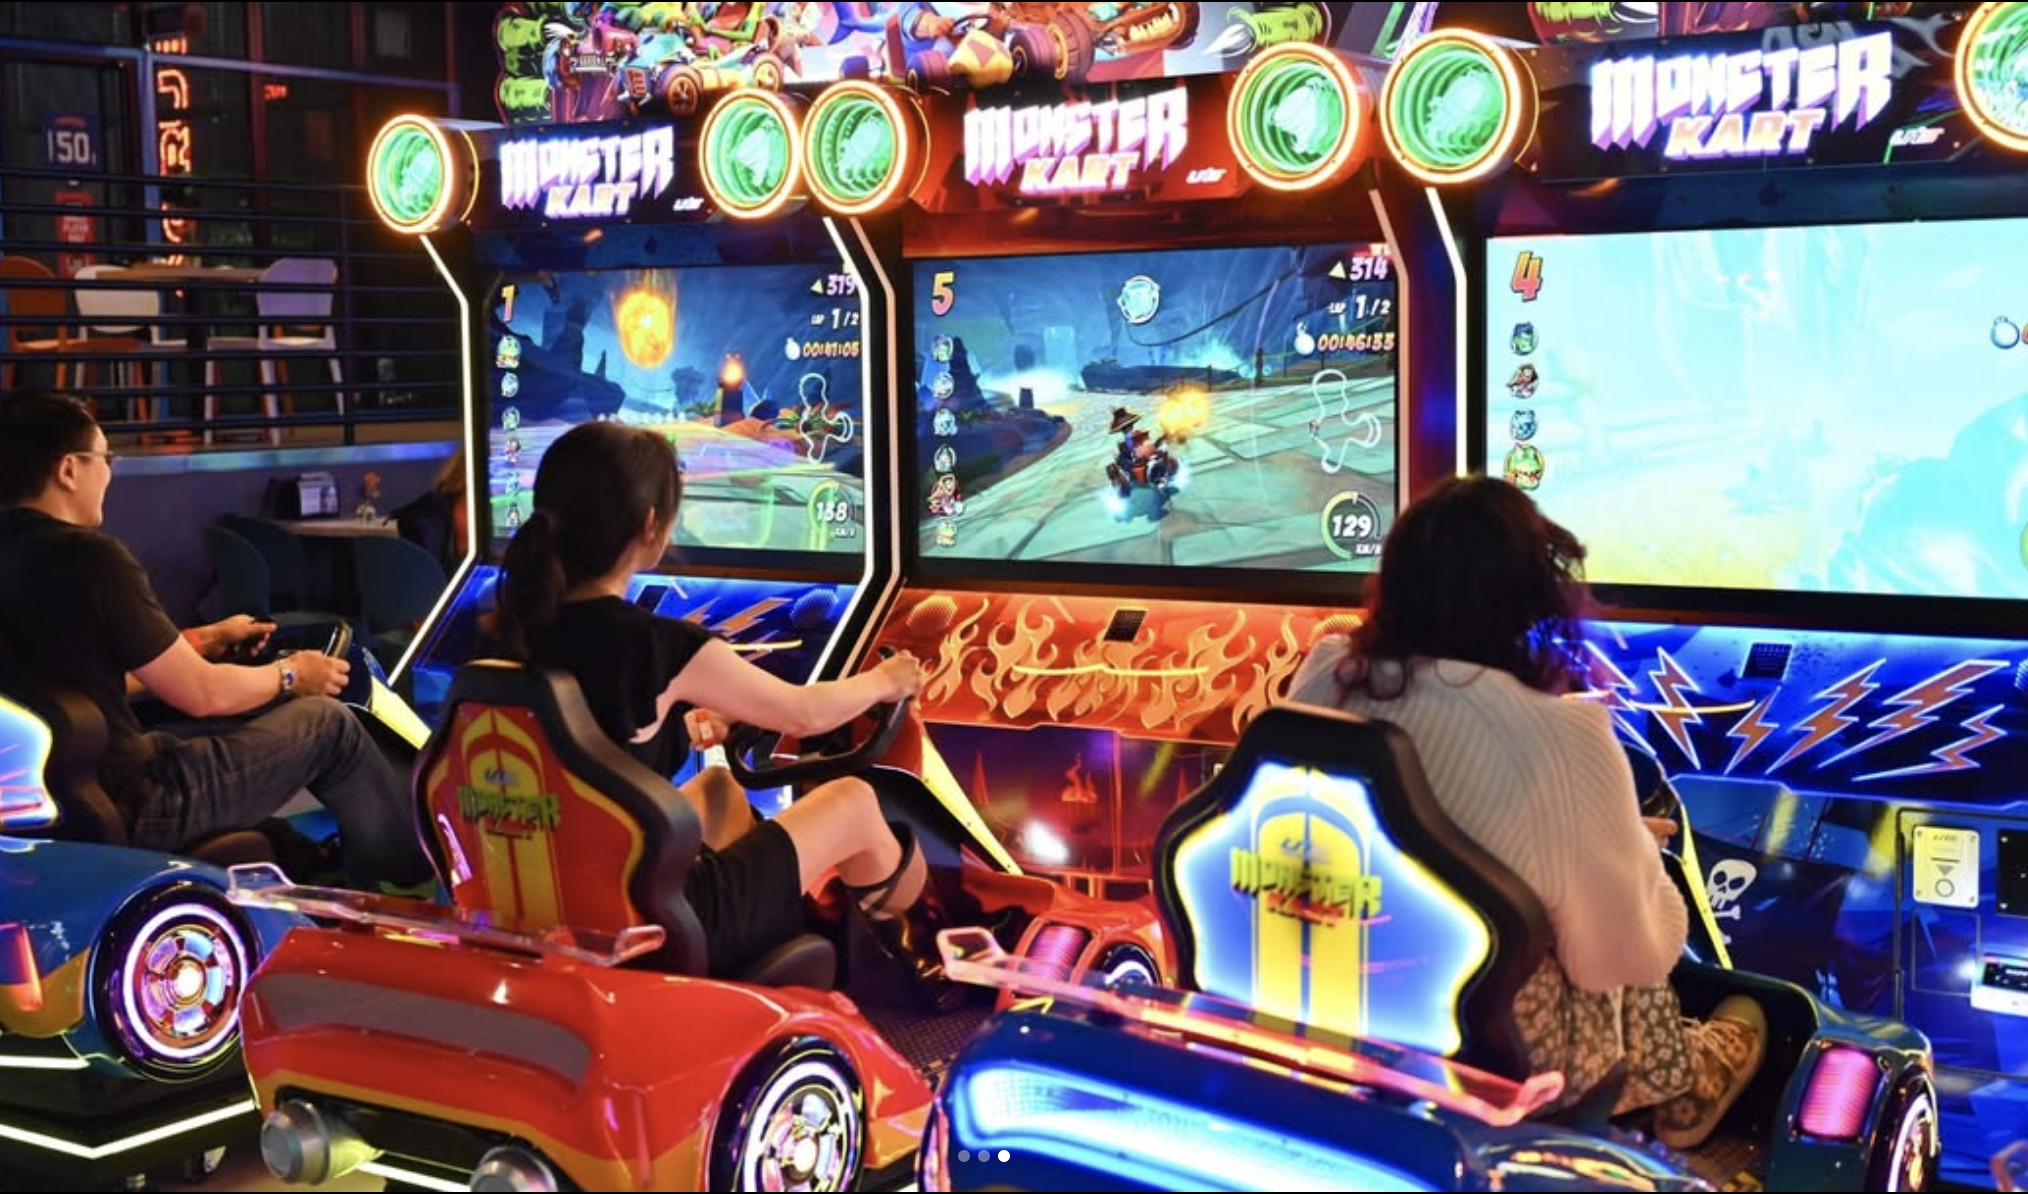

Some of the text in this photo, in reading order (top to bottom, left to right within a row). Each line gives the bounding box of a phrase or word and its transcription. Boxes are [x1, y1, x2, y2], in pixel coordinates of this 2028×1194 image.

[1590, 31, 1892, 150] MONSTER
[964, 86, 1188, 187] MONSTER
[1664, 108, 1827, 161] KART
[499, 125, 675, 211] MONSTER
[1019, 152, 1141, 195] KART
[544, 181, 639, 219] KART
[826, 273, 857, 296] 319
[1349, 256, 1389, 281] 314
[1510, 251, 1543, 303] 4
[501, 284, 515, 323] 1
[932, 271, 954, 316] 5
[1332, 514, 1372, 538] 129
